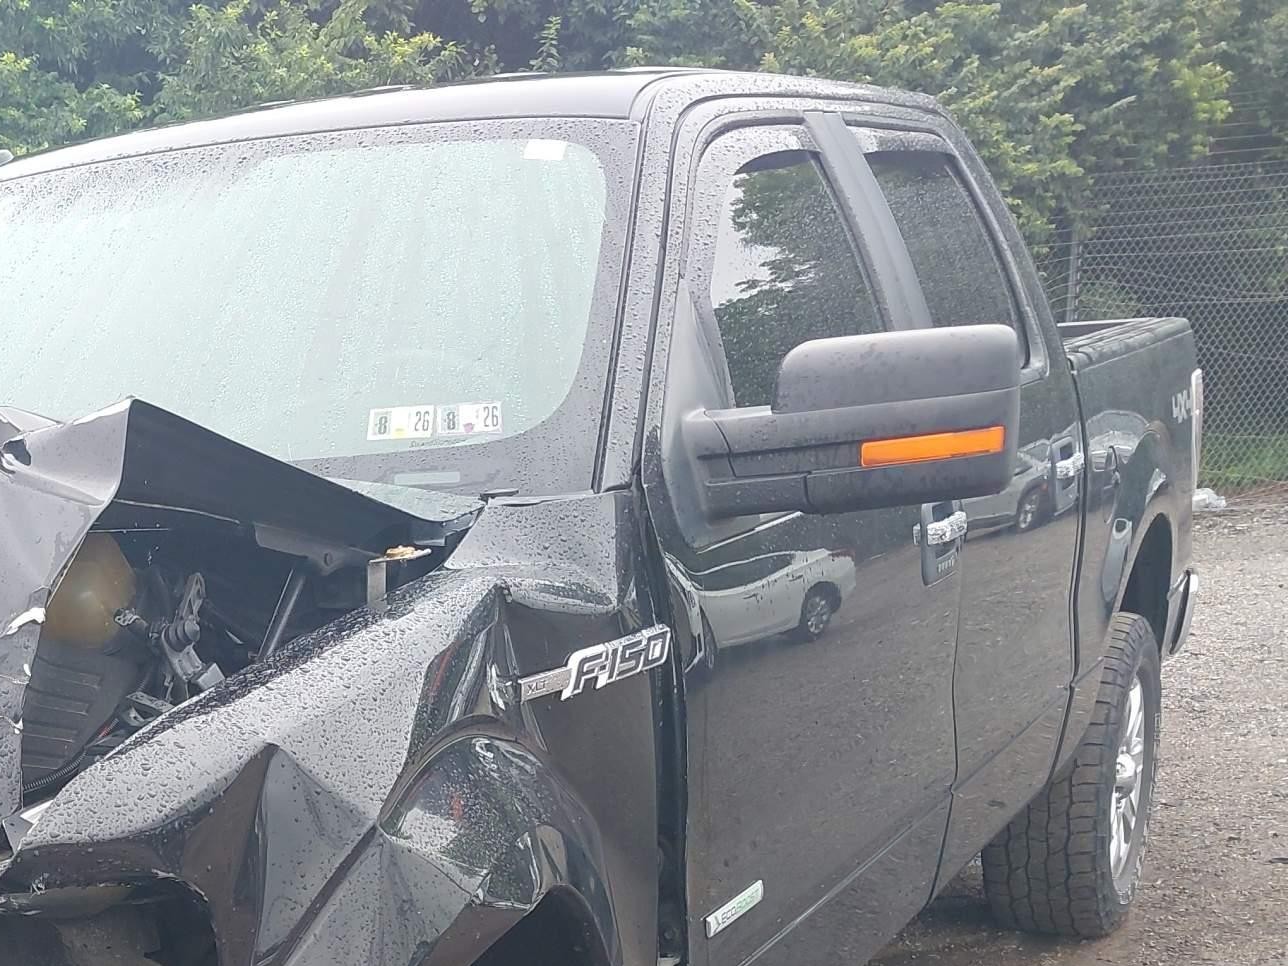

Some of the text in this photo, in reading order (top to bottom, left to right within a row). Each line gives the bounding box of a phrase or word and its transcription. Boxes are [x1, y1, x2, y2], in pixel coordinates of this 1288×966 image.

[377, 410, 431, 435] 8 26
[446, 405, 499, 431] 8 26
